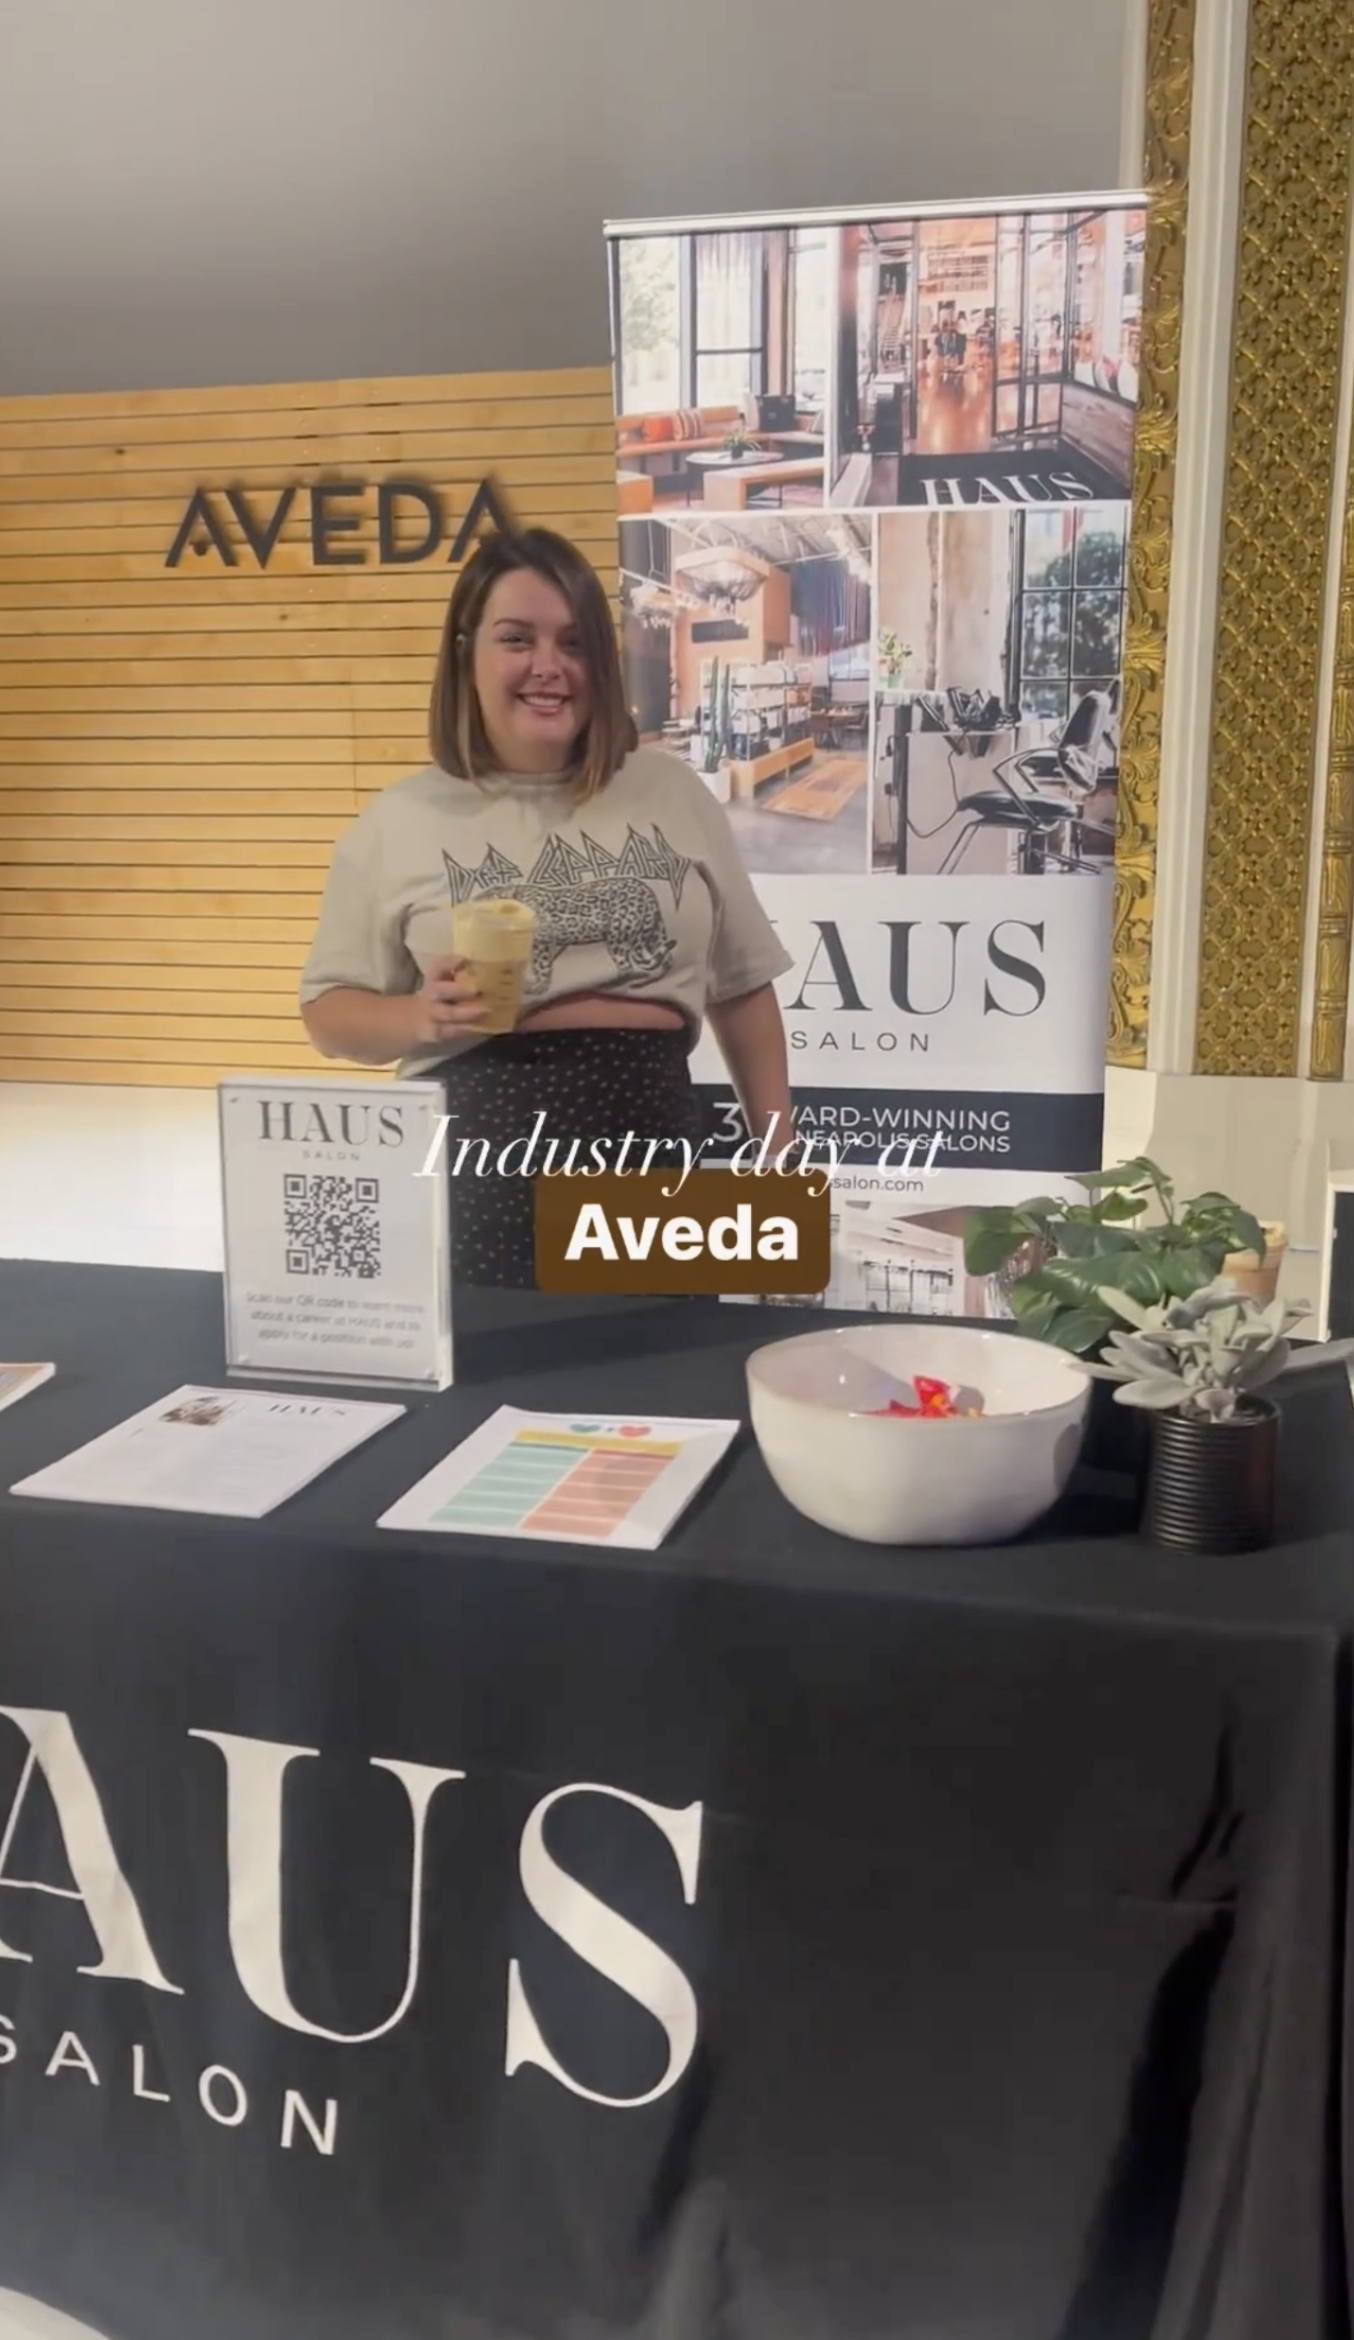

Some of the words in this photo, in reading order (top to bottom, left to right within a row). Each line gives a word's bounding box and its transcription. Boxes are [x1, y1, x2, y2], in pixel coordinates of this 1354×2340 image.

[919, 471, 1094, 506] HAUS
[164, 479, 513, 569] AVEDA
[767, 919, 1047, 1016] AUS
[790, 1030, 930, 1052] SALON
[257, 1100, 404, 1147] HAUS
[711, 1101, 744, 1143] 3
[790, 1105, 1011, 1132] ARD-WINNING
[303, 1149, 360, 1162] SALON
[795, 1130, 910, 1149] NEAPOLIS
[831, 1174, 924, 1193] salon.com
[0, 1705, 703, 2108] AUS
